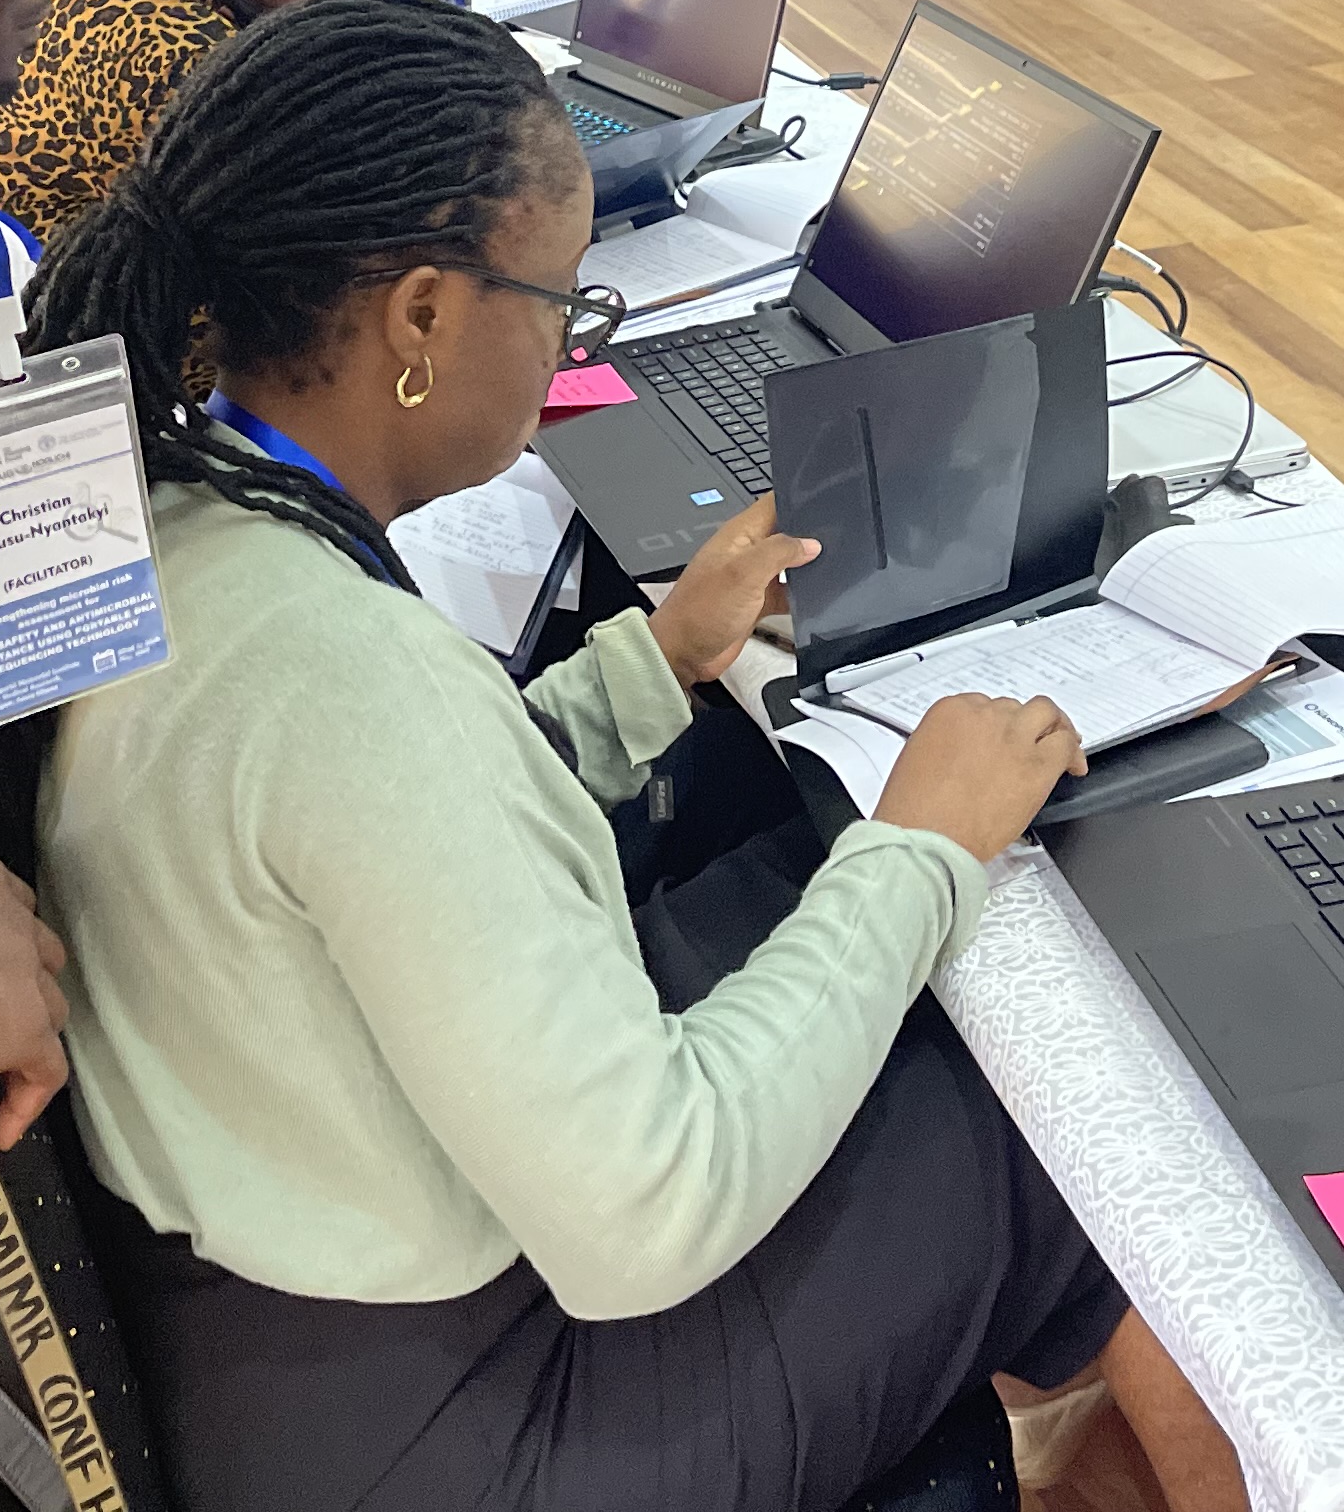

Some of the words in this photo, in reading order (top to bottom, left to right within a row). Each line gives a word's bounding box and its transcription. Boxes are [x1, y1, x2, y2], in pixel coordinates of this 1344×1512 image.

[0, 495, 72, 525] Christian
[3, 554, 93, 594] (FACILITATOR)
[111, 573, 133, 587] risk
[43, 619, 67, 636] AND
[68, 591, 154, 627] ANTIMICROBIAL
[38, 1374, 107, 1483] CONF
